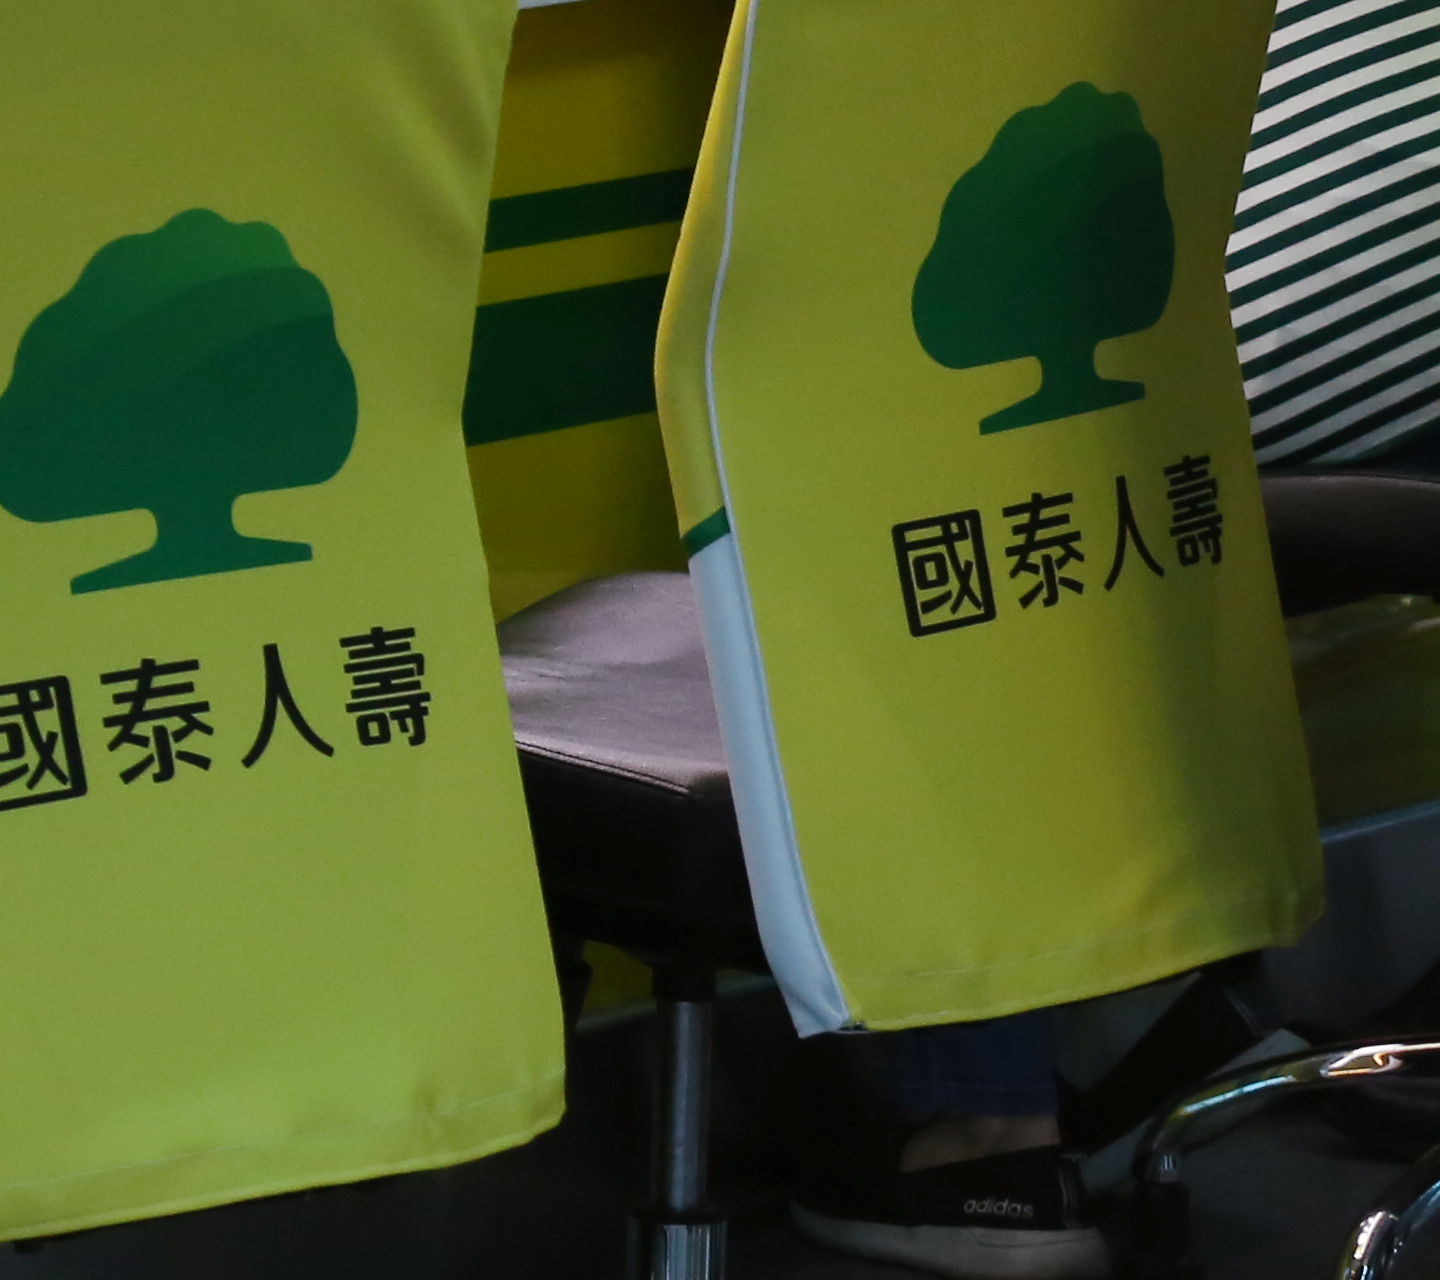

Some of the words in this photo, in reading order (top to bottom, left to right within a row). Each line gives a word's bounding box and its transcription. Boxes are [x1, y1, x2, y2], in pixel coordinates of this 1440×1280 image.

[891, 454, 1224, 638] 國泰人壽
[964, 1198, 1034, 1219] adidas
